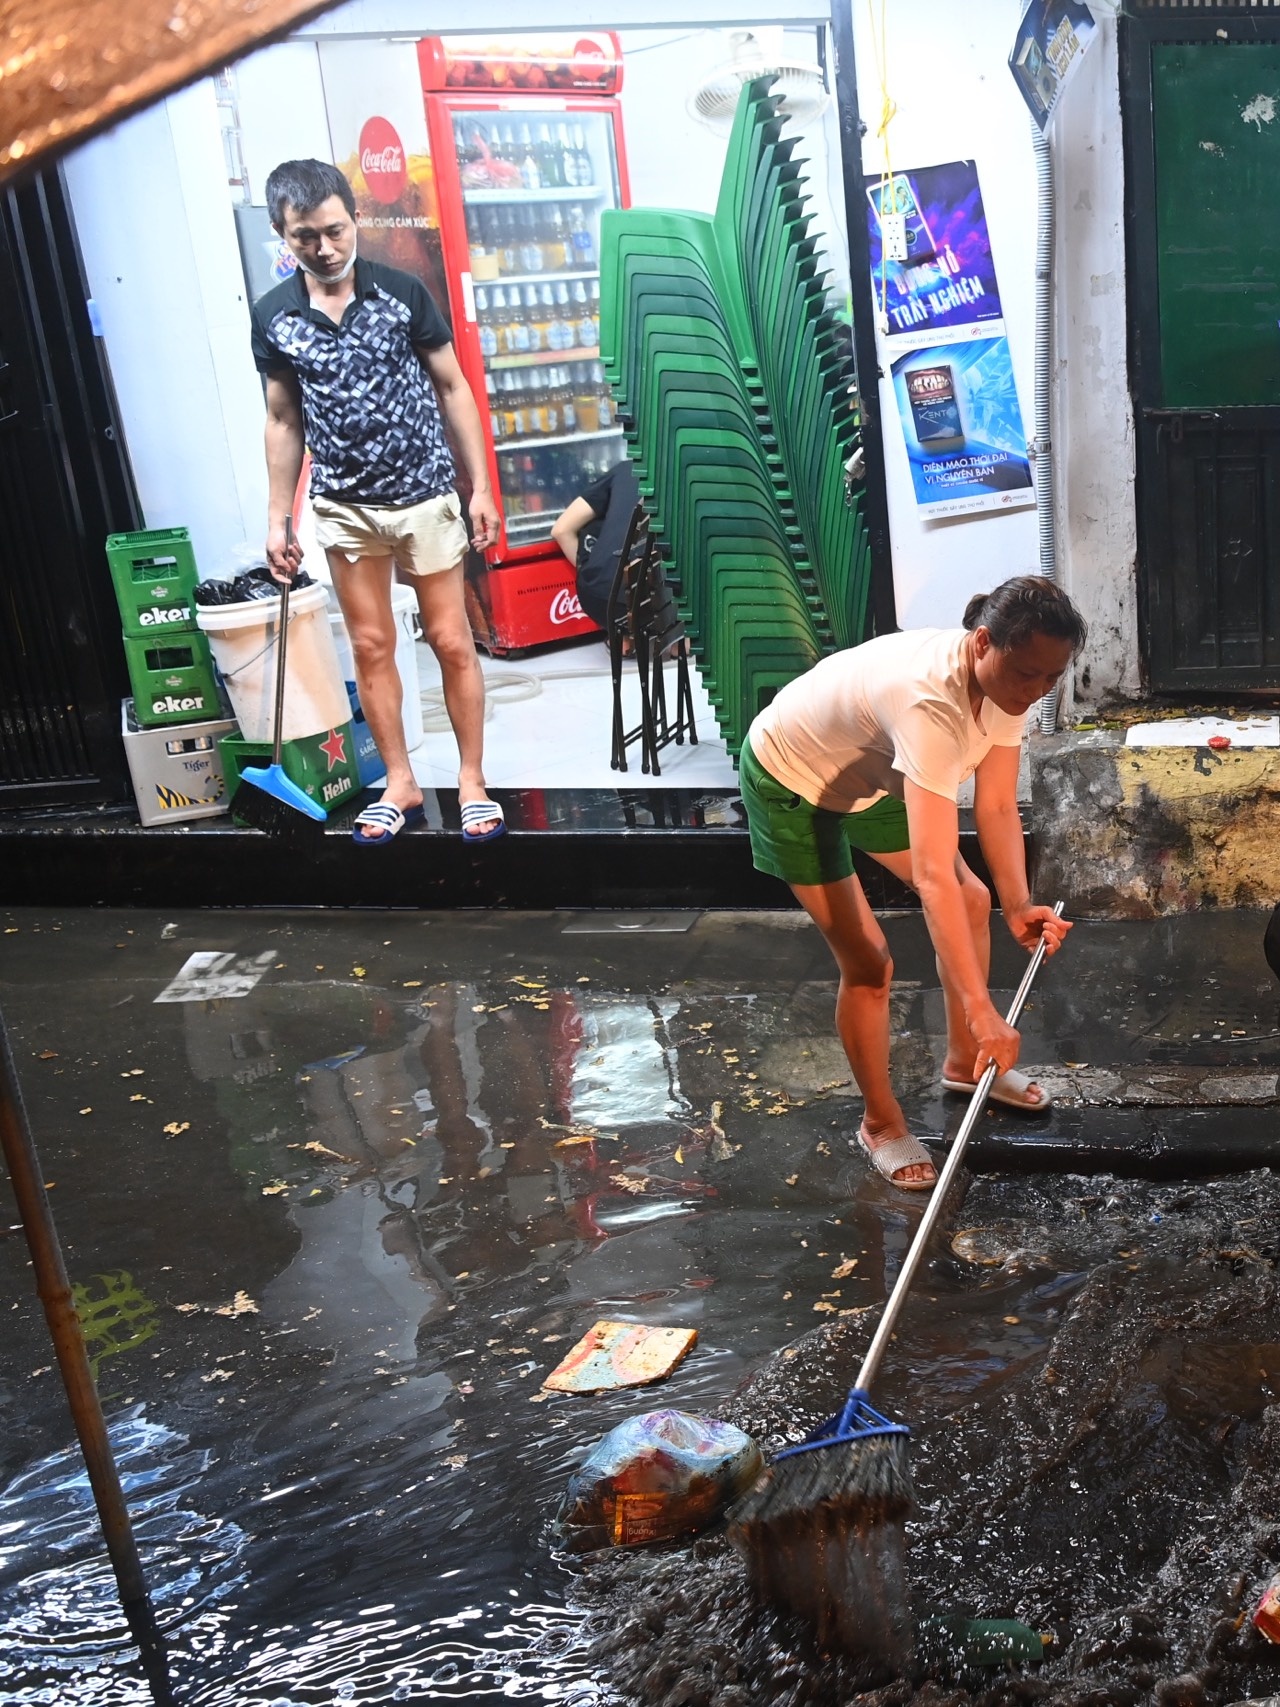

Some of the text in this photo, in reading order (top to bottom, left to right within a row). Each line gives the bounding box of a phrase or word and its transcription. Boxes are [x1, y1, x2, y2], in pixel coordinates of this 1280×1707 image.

[929, 275, 985, 309] NGHIỆM
[946, 458, 968, 472] MẠO
[992, 452, 1008, 464] ĐẠI
[937, 468, 975, 483] NGUYÊN
[183, 760, 210, 772] Tiger
[322, 776, 352, 802] Hein
